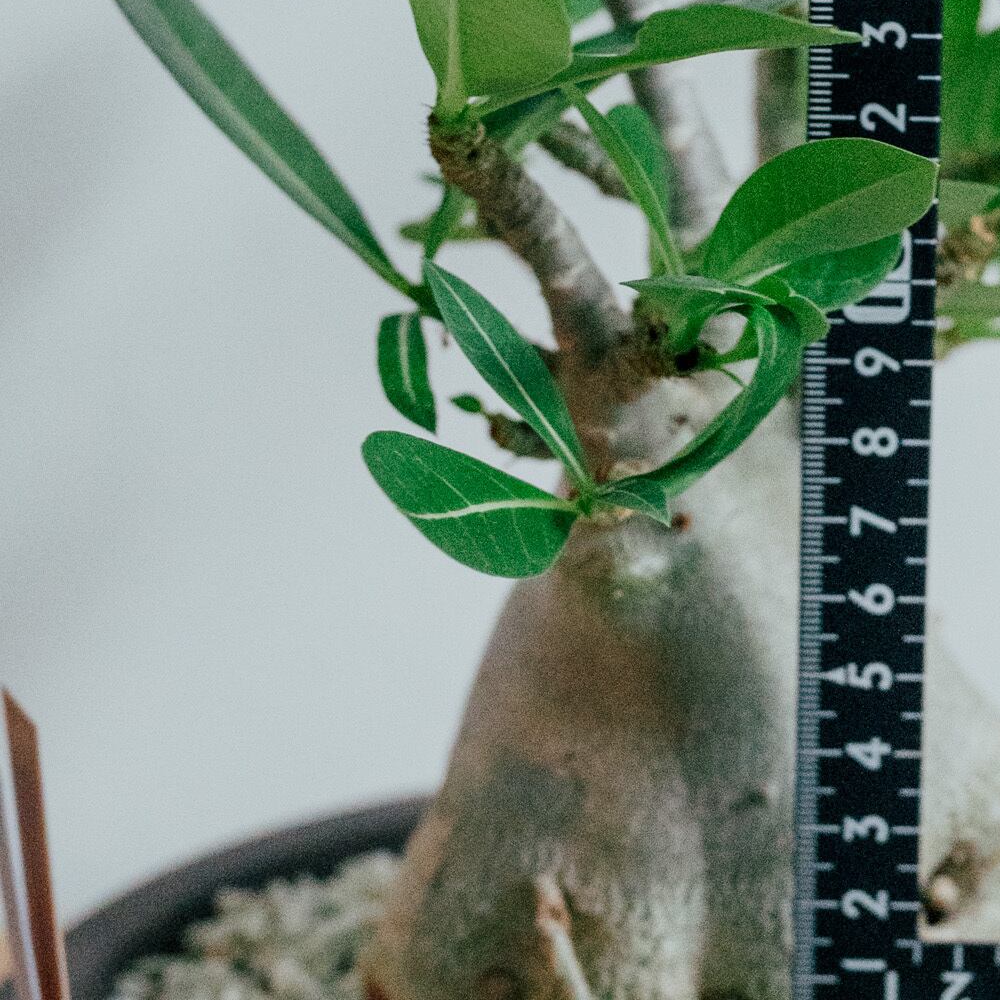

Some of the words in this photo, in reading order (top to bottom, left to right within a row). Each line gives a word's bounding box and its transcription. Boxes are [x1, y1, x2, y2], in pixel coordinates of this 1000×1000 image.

[861, 20, 908, 50] 3
[860, 102, 907, 133] 2
[854, 347, 901, 377] 9
[852, 427, 900, 458] 8
[849, 506, 897, 537] 7
[848, 583, 895, 615] 6
[847, 662, 893, 691] 5
[845, 737, 892, 771] 4
[843, 814, 890, 843] 3
[842, 889, 889, 919] 2
